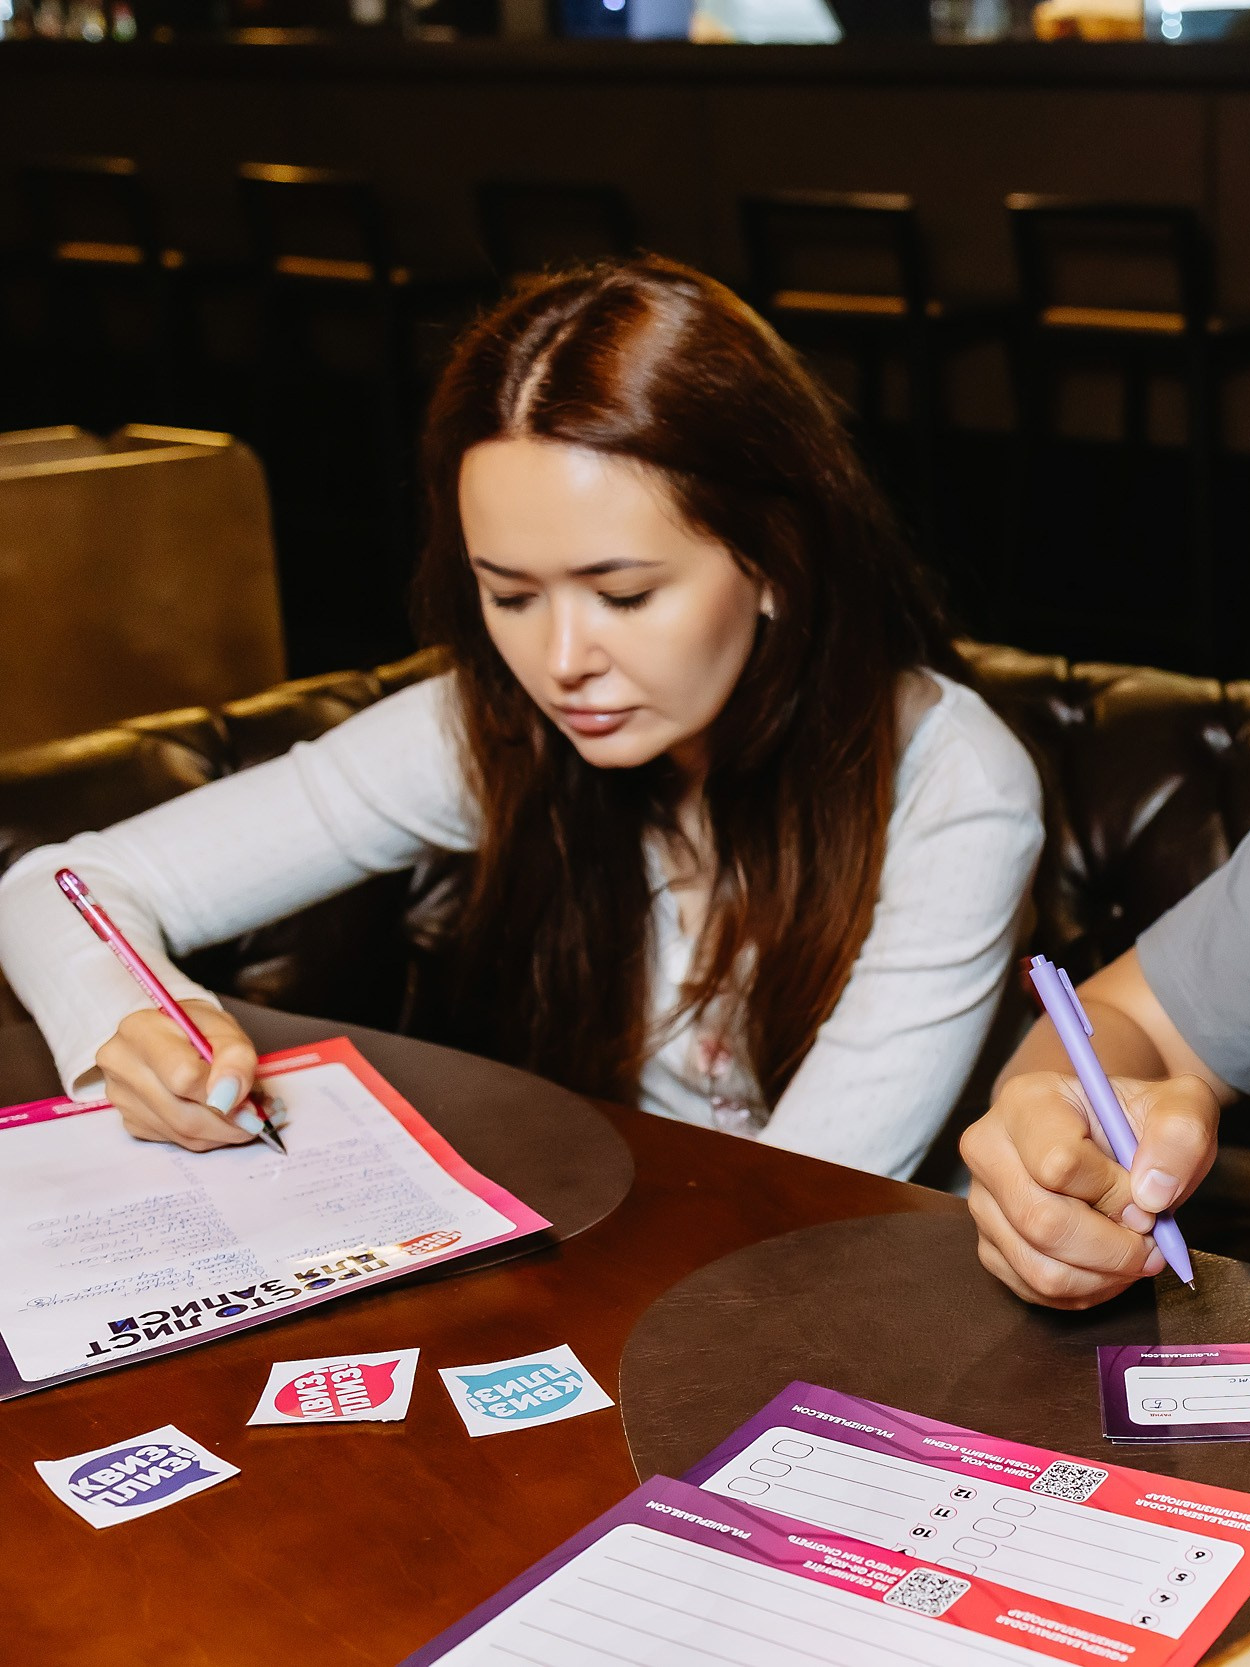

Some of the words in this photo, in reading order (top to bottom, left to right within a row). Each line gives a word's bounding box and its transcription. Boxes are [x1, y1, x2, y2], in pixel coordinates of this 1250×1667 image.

[294, 1252, 376, 1282] ДЛЯ
[215, 1260, 390, 1318] ПРОСТО
[108, 1280, 285, 1334] ЗАПИСИ
[86, 1314, 202, 1358] ЛИСТ
[466, 1364, 572, 1407] ПЛИЗ!
[1150, 1399, 1162, 1409] 5
[791, 1404, 895, 1440] PVL.QUIZPLEASE.COM
[922, 1438, 959, 1452] ВСЕМИ
[960, 1447, 1004, 1464] ПРАВИТЬ
[1005, 1458, 1042, 1472] ЧТОБЫ
[1004, 1466, 1036, 1479] ОДИН
[954, 1488, 972, 1498] 12
[934, 1507, 951, 1518] 11
[646, 1500, 752, 1540] PVL.QUIZPLEASE.COM
[912, 1527, 933, 1538] 10
[788, 1534, 842, 1556] СМОТРЕТЬ
[840, 1552, 865, 1564] ТАМ
[1194, 1551, 1206, 1560] 6
[802, 1560, 873, 1587] СКАНИРУЙТЕ
[864, 1560, 906, 1576] НЕЧЕГО
[867, 1570, 898, 1584] ЭТОТ
[1176, 1573, 1188, 1582] 5
[872, 1582, 890, 1592] НЕ
[1160, 1594, 1170, 1603] 4
[1139, 1616, 1151, 1624] 3
[996, 1615, 1128, 1662] #QUIZPLEASEPAVLODAR
